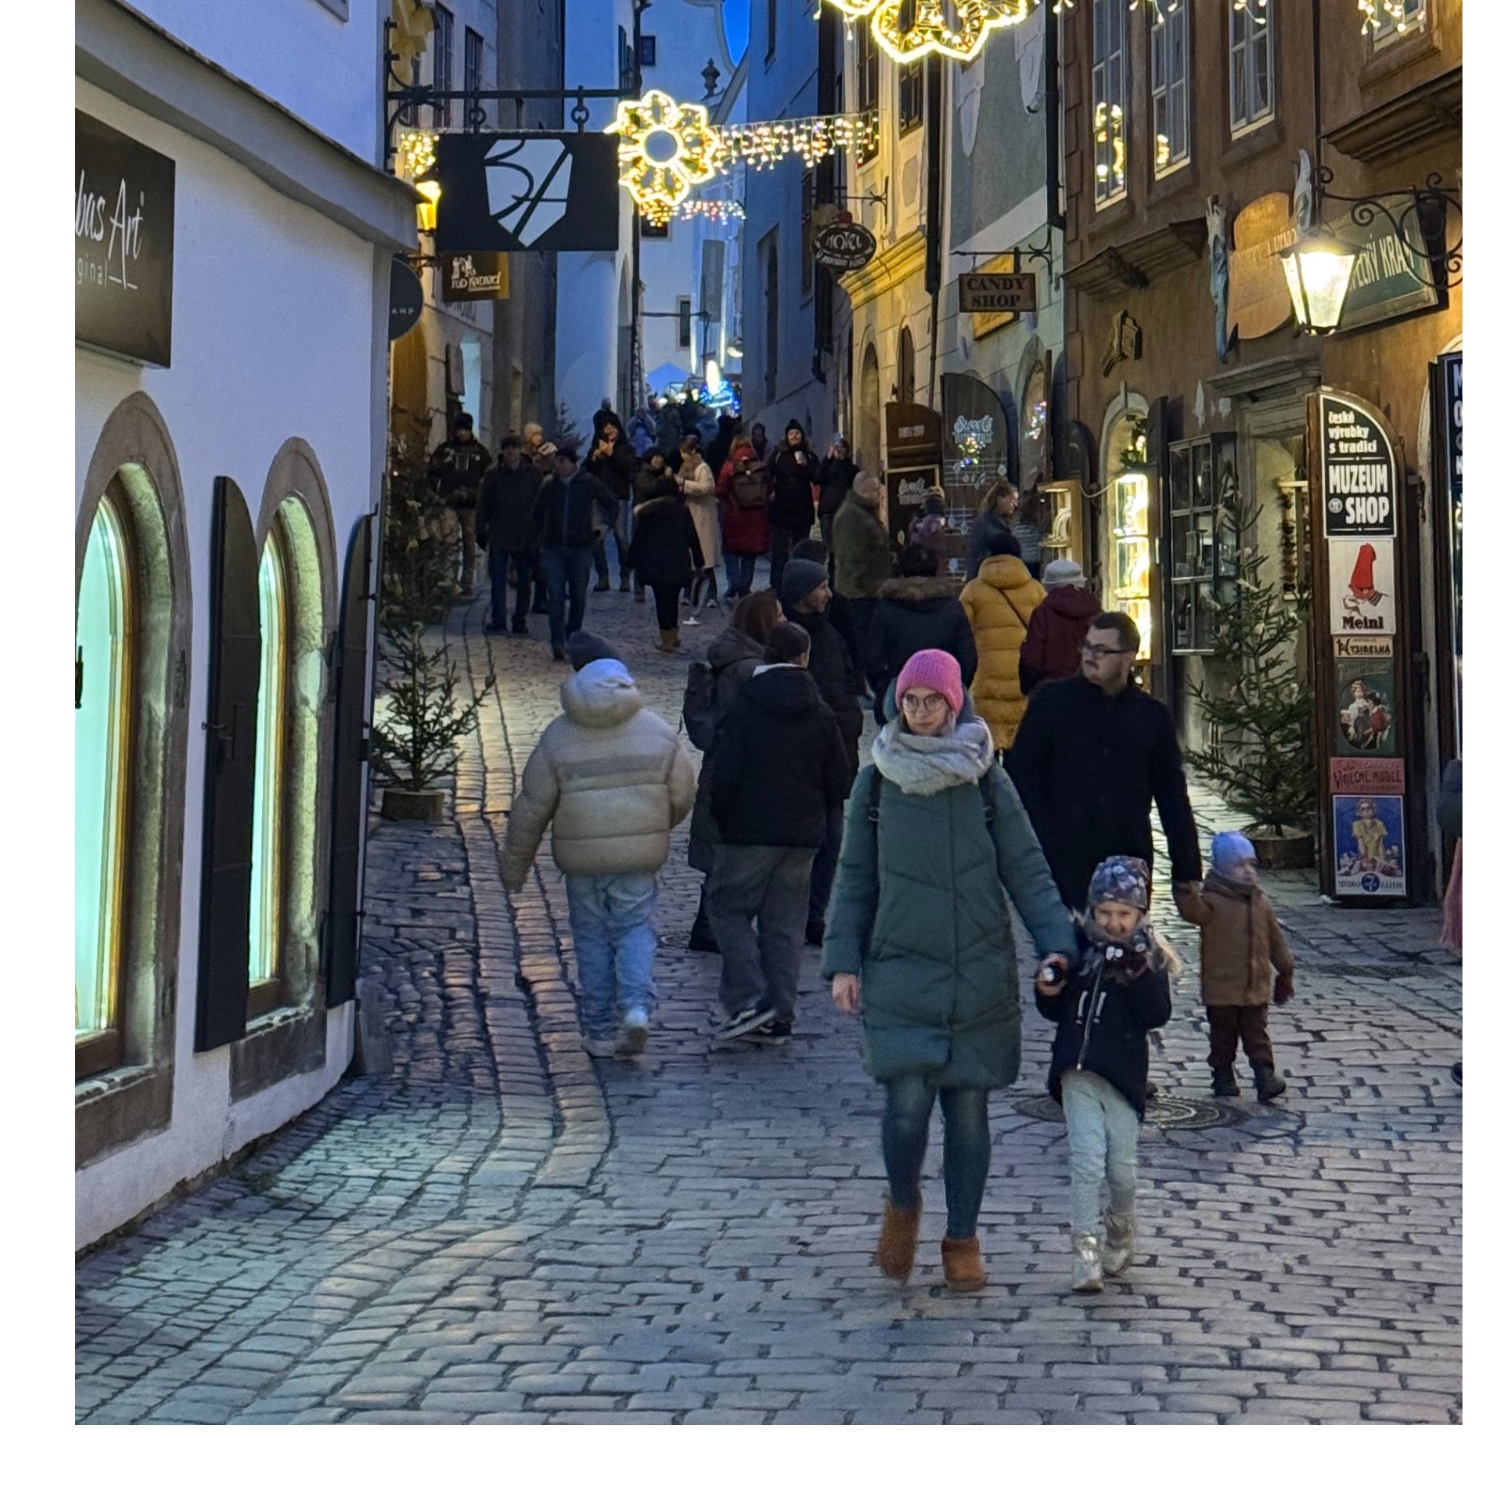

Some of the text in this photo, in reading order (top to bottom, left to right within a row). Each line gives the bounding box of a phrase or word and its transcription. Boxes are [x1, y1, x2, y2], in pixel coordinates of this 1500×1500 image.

[966, 277, 1026, 291] CANDY
[971, 294, 1021, 308] SHOP
[1328, 442, 1336, 454] s
[1328, 464, 1388, 494] MUZEUM
[1345, 496, 1390, 525] SHOP
[1342, 616, 1384, 630] Meinl
